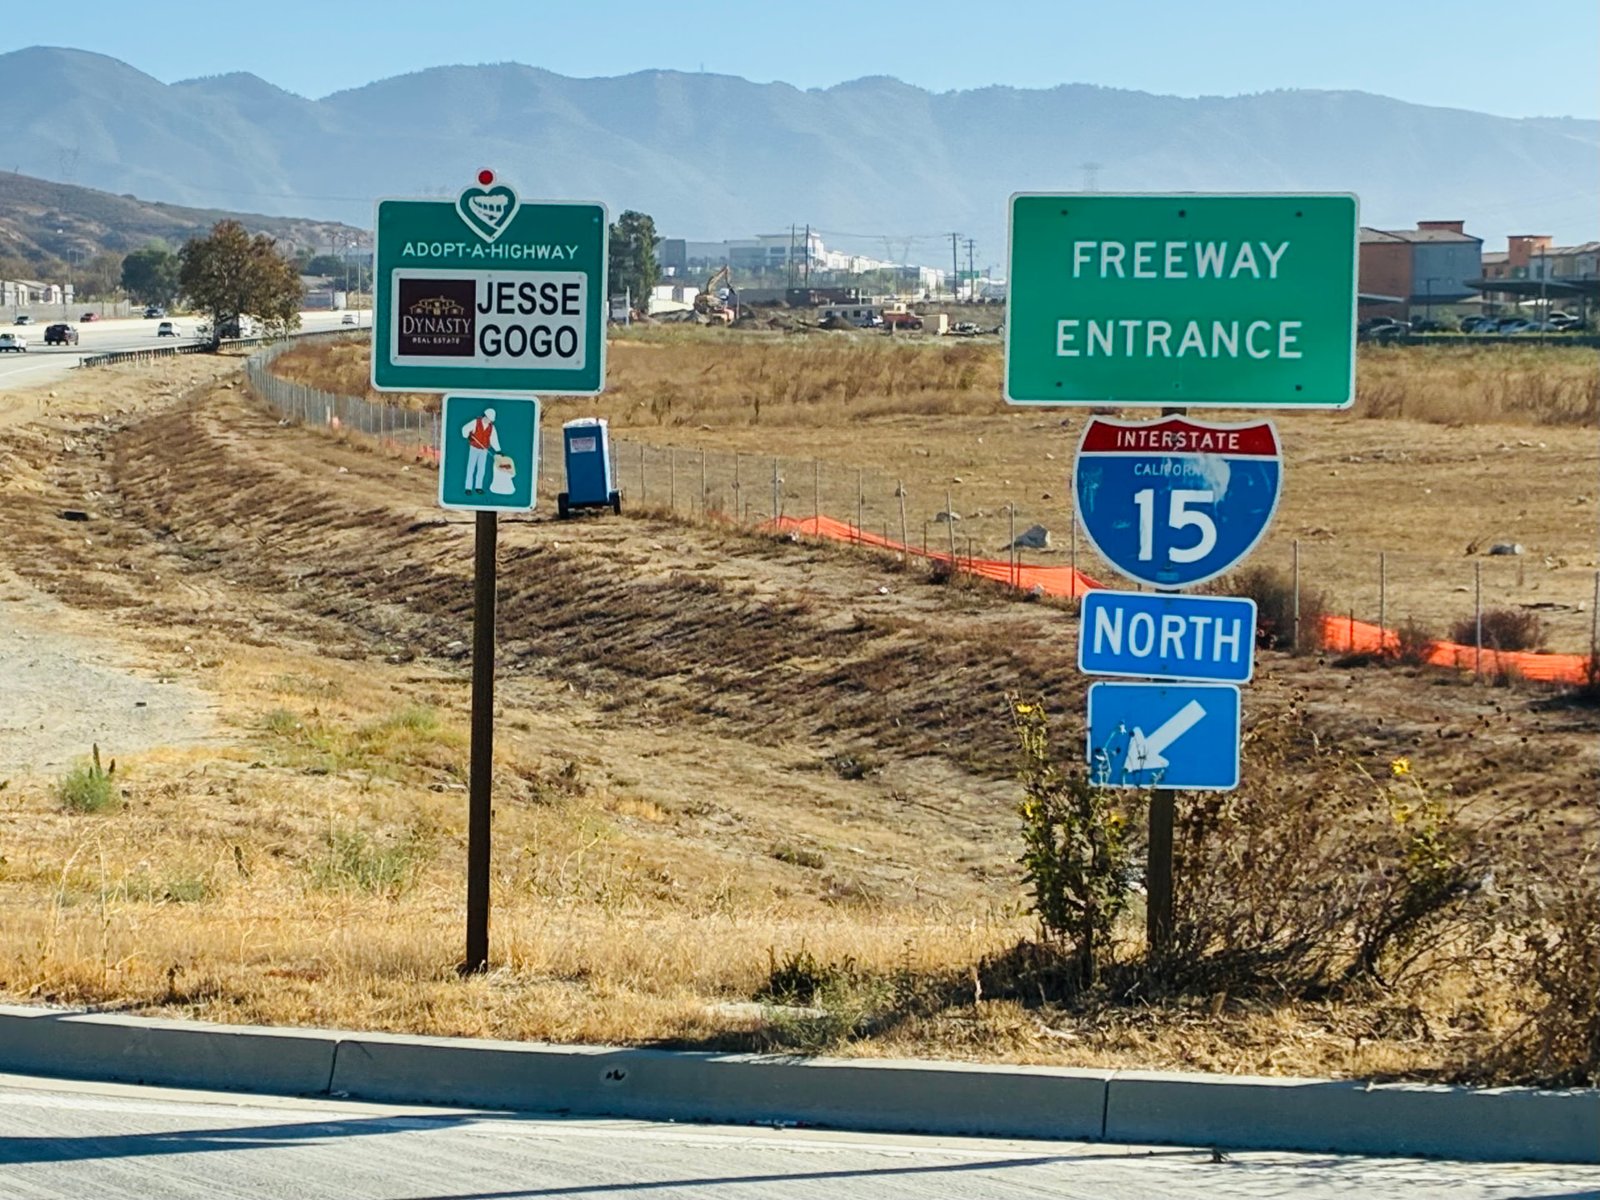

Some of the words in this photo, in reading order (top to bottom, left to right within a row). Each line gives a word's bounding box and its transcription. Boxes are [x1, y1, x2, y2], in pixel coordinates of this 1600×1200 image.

[402, 241, 579, 260] ADOPT-A-HIGHWAY
[1072, 240, 1290, 279] FREEWAY
[477, 281, 581, 316] JESSE
[479, 324, 578, 358] GOGO
[1056, 319, 1303, 359] ENTRANCE
[1116, 430, 1241, 450] INTERSTATE
[1134, 488, 1217, 563] 15
[1093, 606, 1242, 663] NORTH
